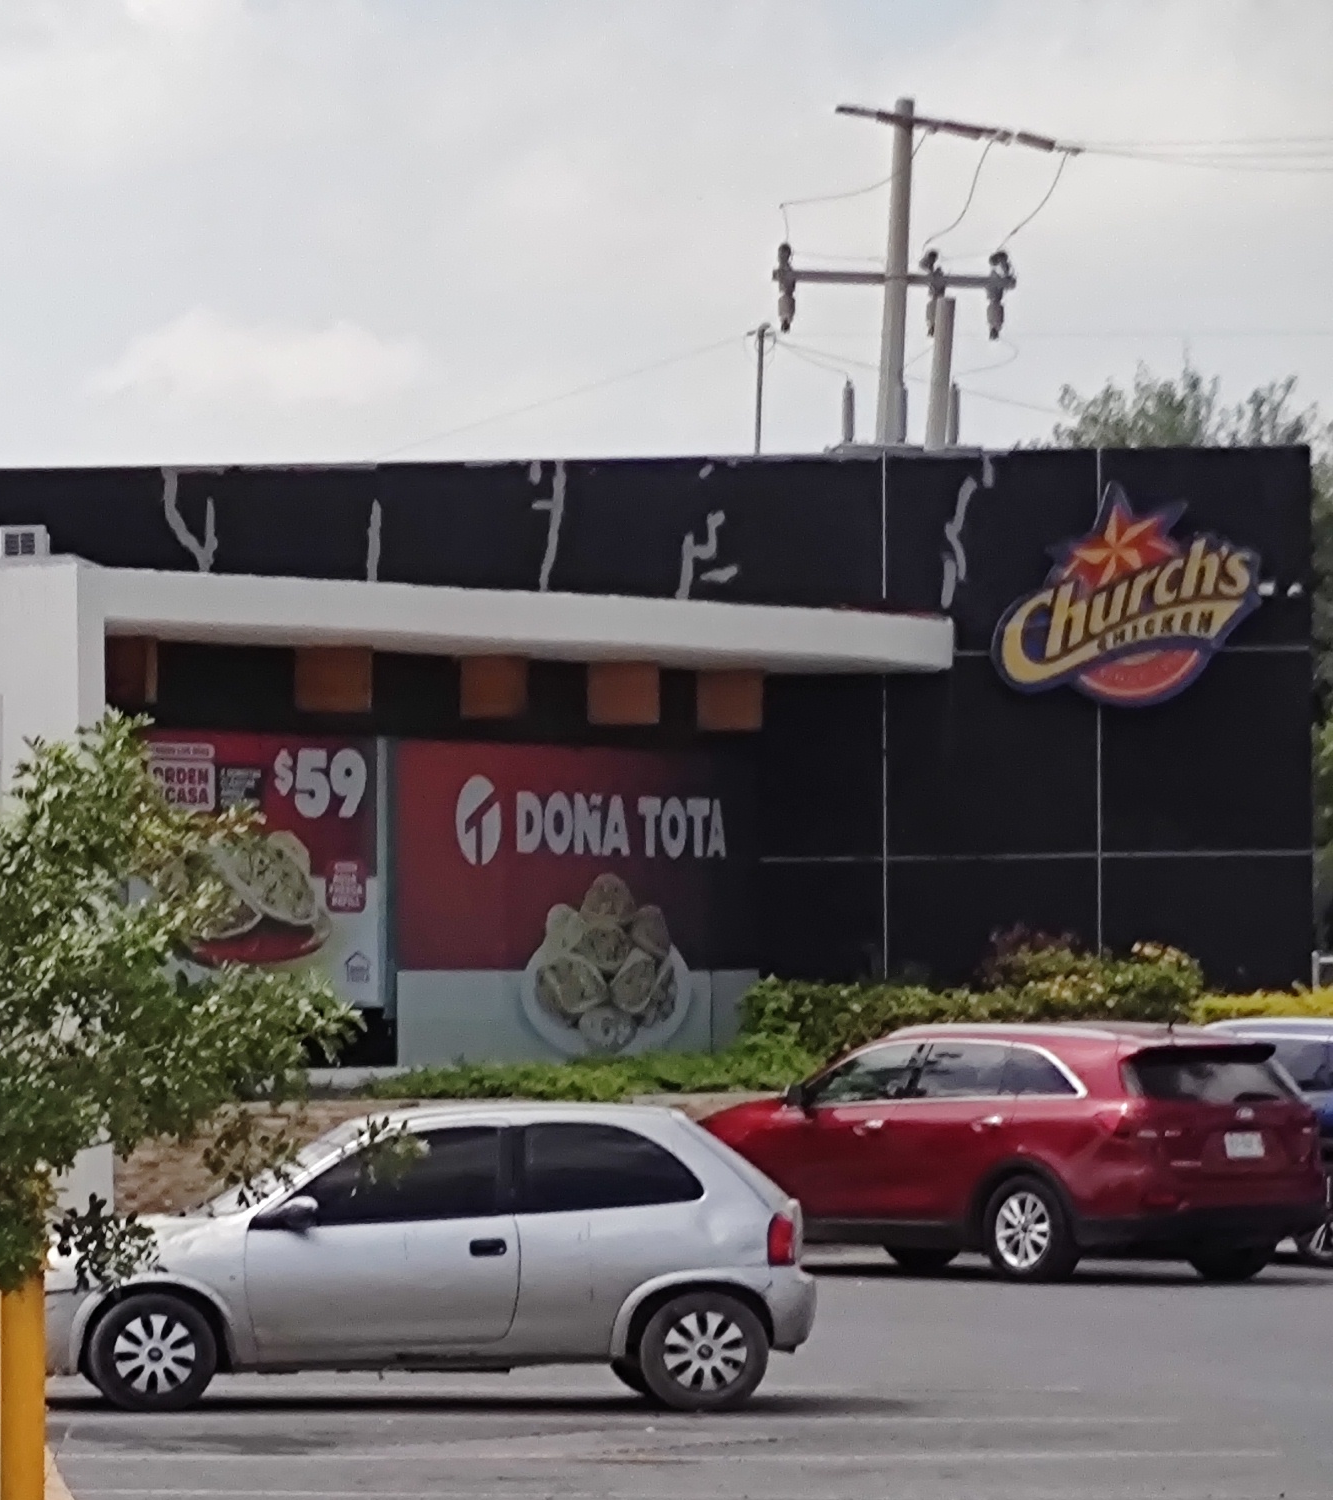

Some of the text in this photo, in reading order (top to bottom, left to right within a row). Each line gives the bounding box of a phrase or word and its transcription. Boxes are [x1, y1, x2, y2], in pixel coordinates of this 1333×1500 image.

[1002, 537, 1250, 683] Church's
[1097, 609, 1215, 650] CHICKEN
[152, 767, 209, 785] ORDEN
[274, 748, 367, 818] $59
[515, 790, 727, 861] DOÑA TOTA
